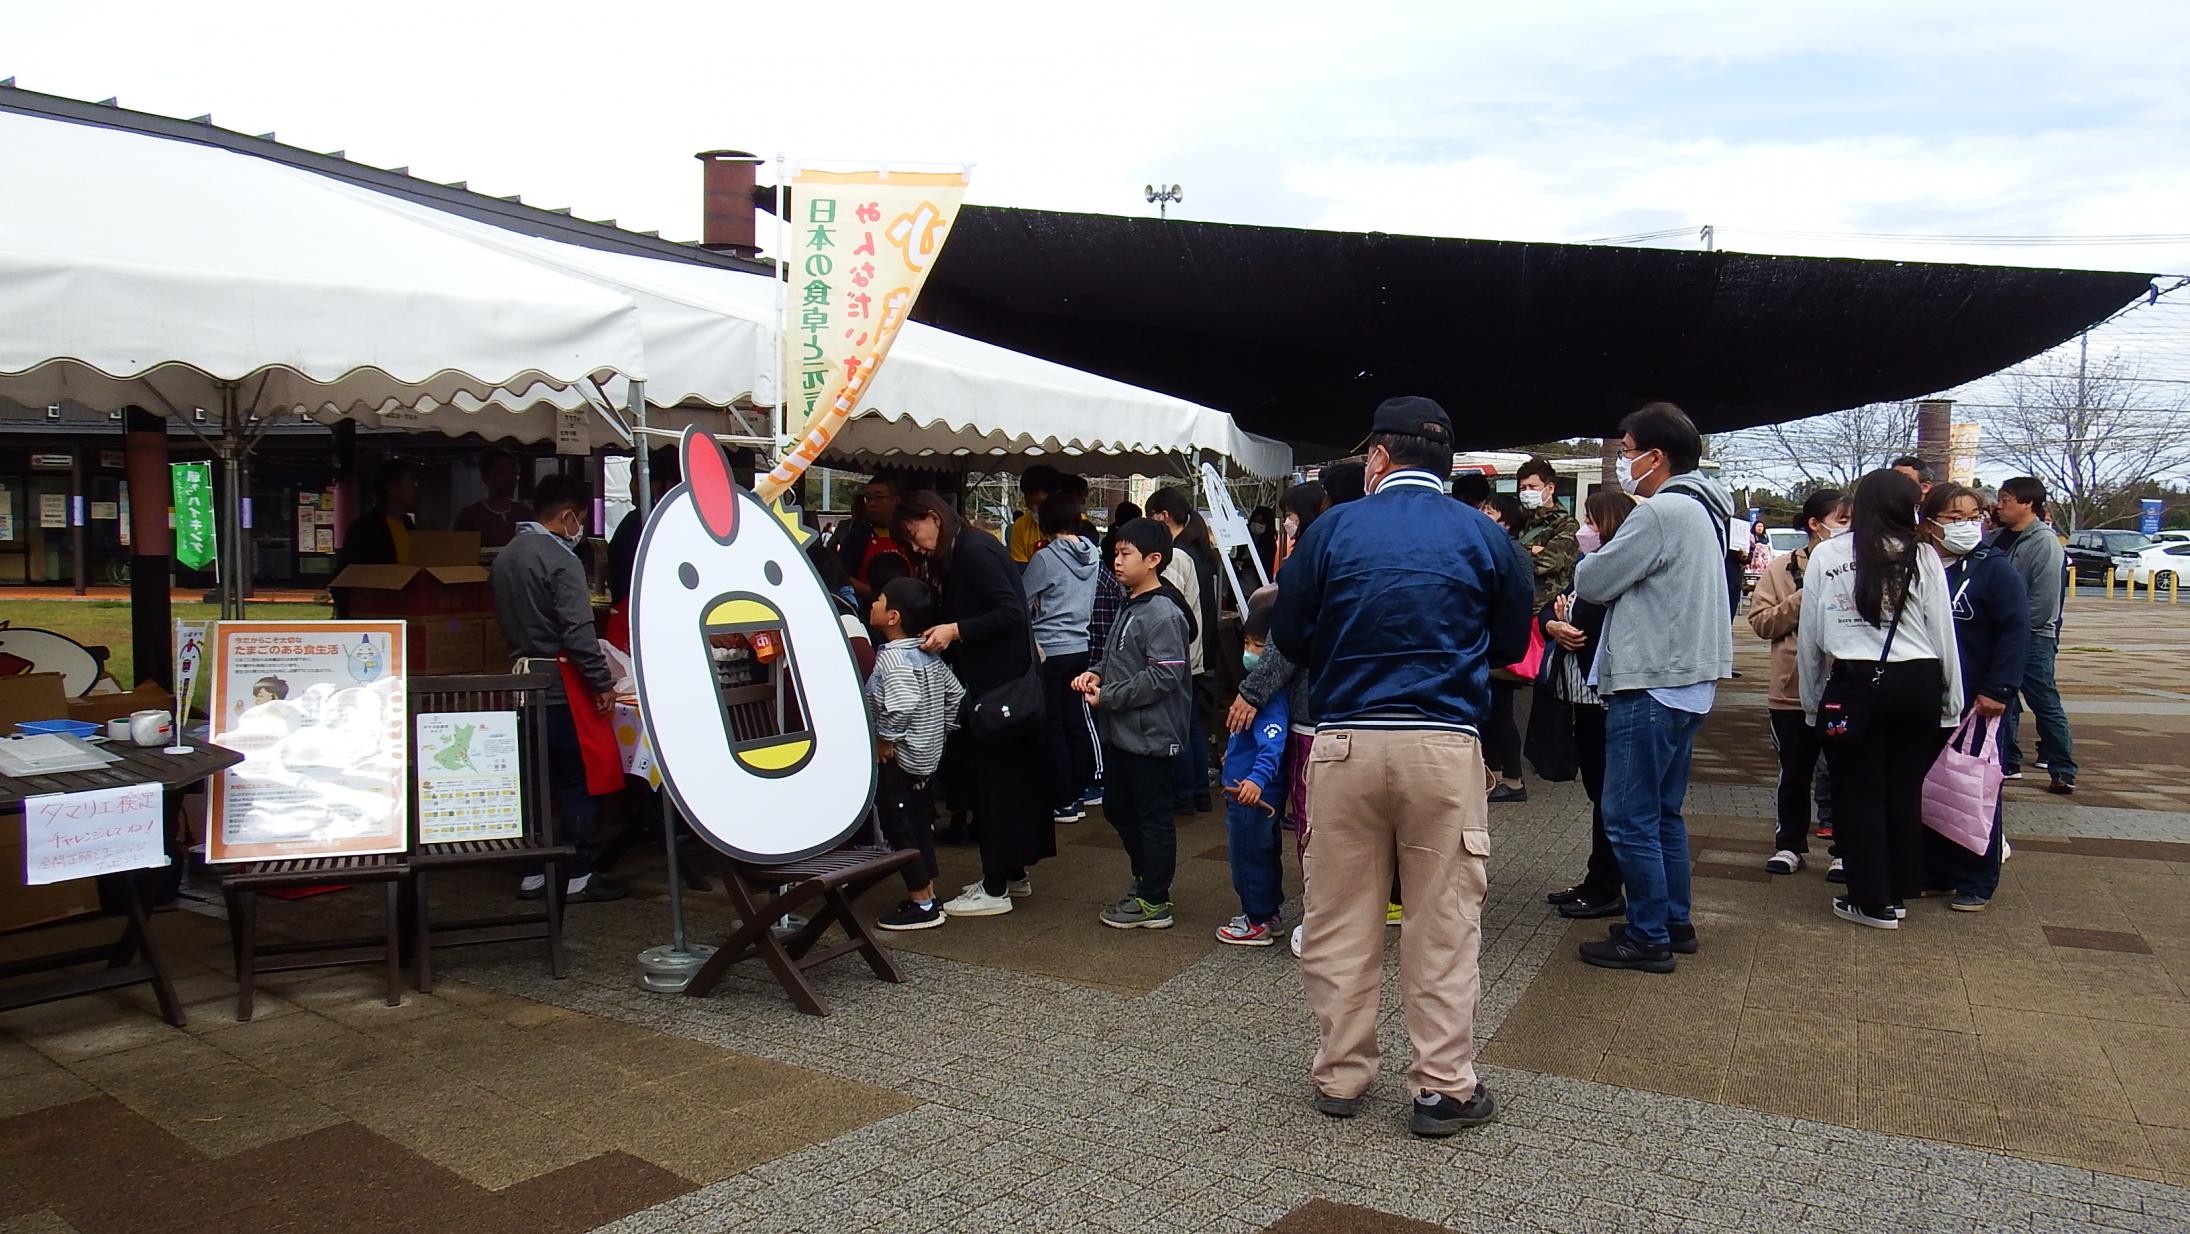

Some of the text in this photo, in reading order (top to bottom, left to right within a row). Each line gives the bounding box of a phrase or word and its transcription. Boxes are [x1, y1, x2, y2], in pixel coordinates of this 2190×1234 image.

[1825, 561, 1857, 581] Swee
[234, 644, 339, 655] たまごのある食生活
[40, 791, 155, 827] タマリエ検定
